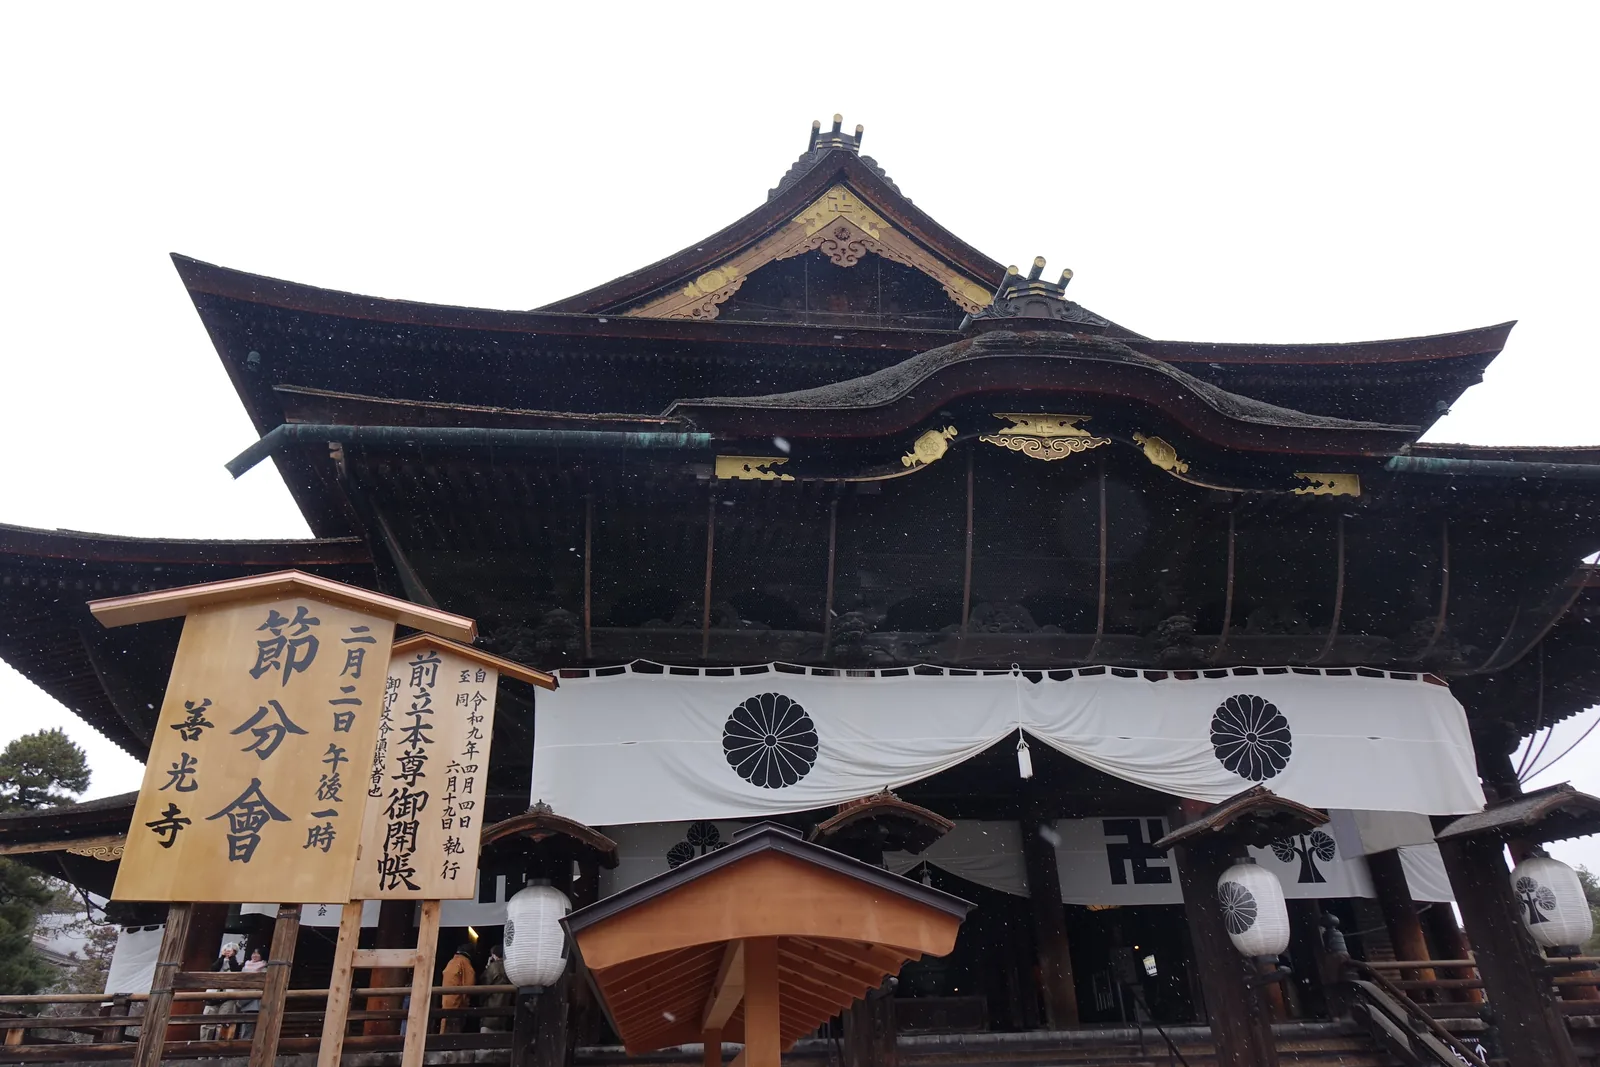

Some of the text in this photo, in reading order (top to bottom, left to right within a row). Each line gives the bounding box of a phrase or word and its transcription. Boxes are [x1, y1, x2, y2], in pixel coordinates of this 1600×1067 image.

[145, 698, 215, 849] 善光寺
[205, 606, 321, 864] 節分會
[377, 650, 442, 891] 前立本尊御開帳
